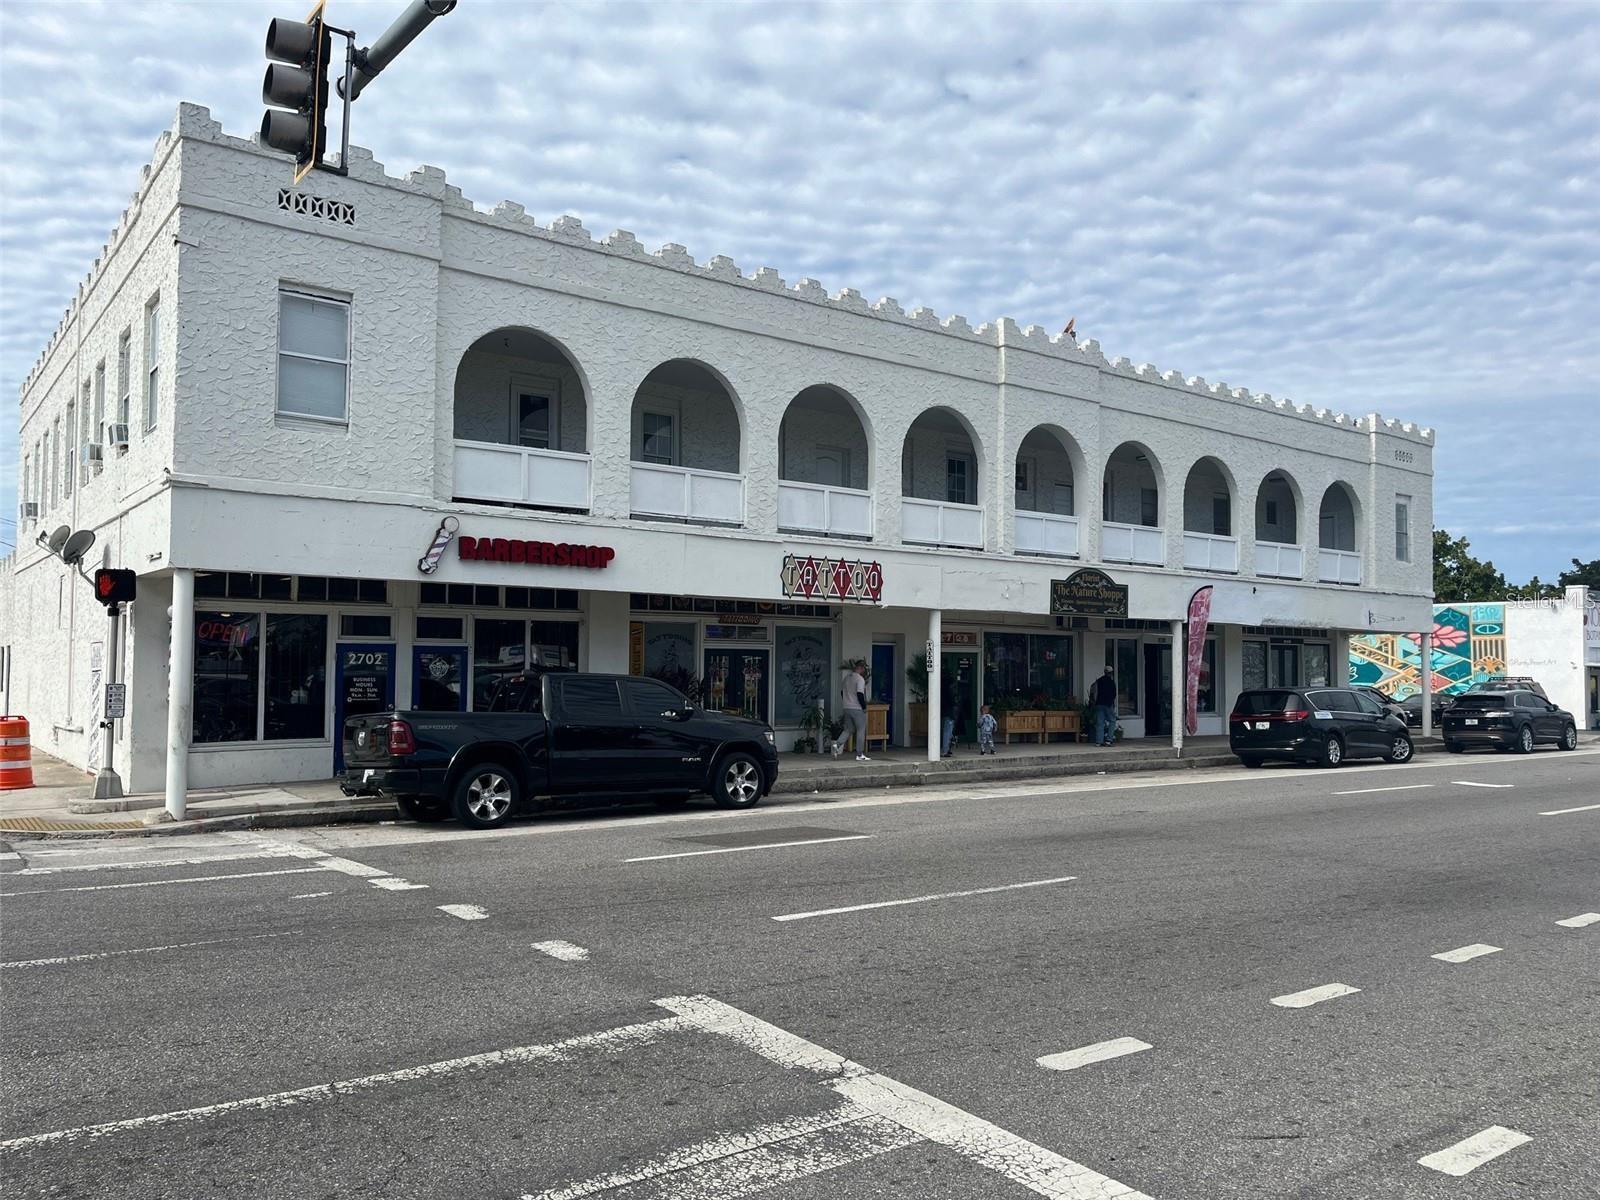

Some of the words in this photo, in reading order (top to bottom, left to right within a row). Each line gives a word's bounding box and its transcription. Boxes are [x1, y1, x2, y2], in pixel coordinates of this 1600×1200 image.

[459, 536, 615, 568] BARBERSHOP
[786, 565, 879, 591] TATTOO
[1056, 584, 1070, 596] The
[1071, 585, 1097, 597] Nature
[1099, 586, 1124, 601] Shoppe
[198, 621, 249, 644] OPEN
[349, 653, 382, 665] 2702
